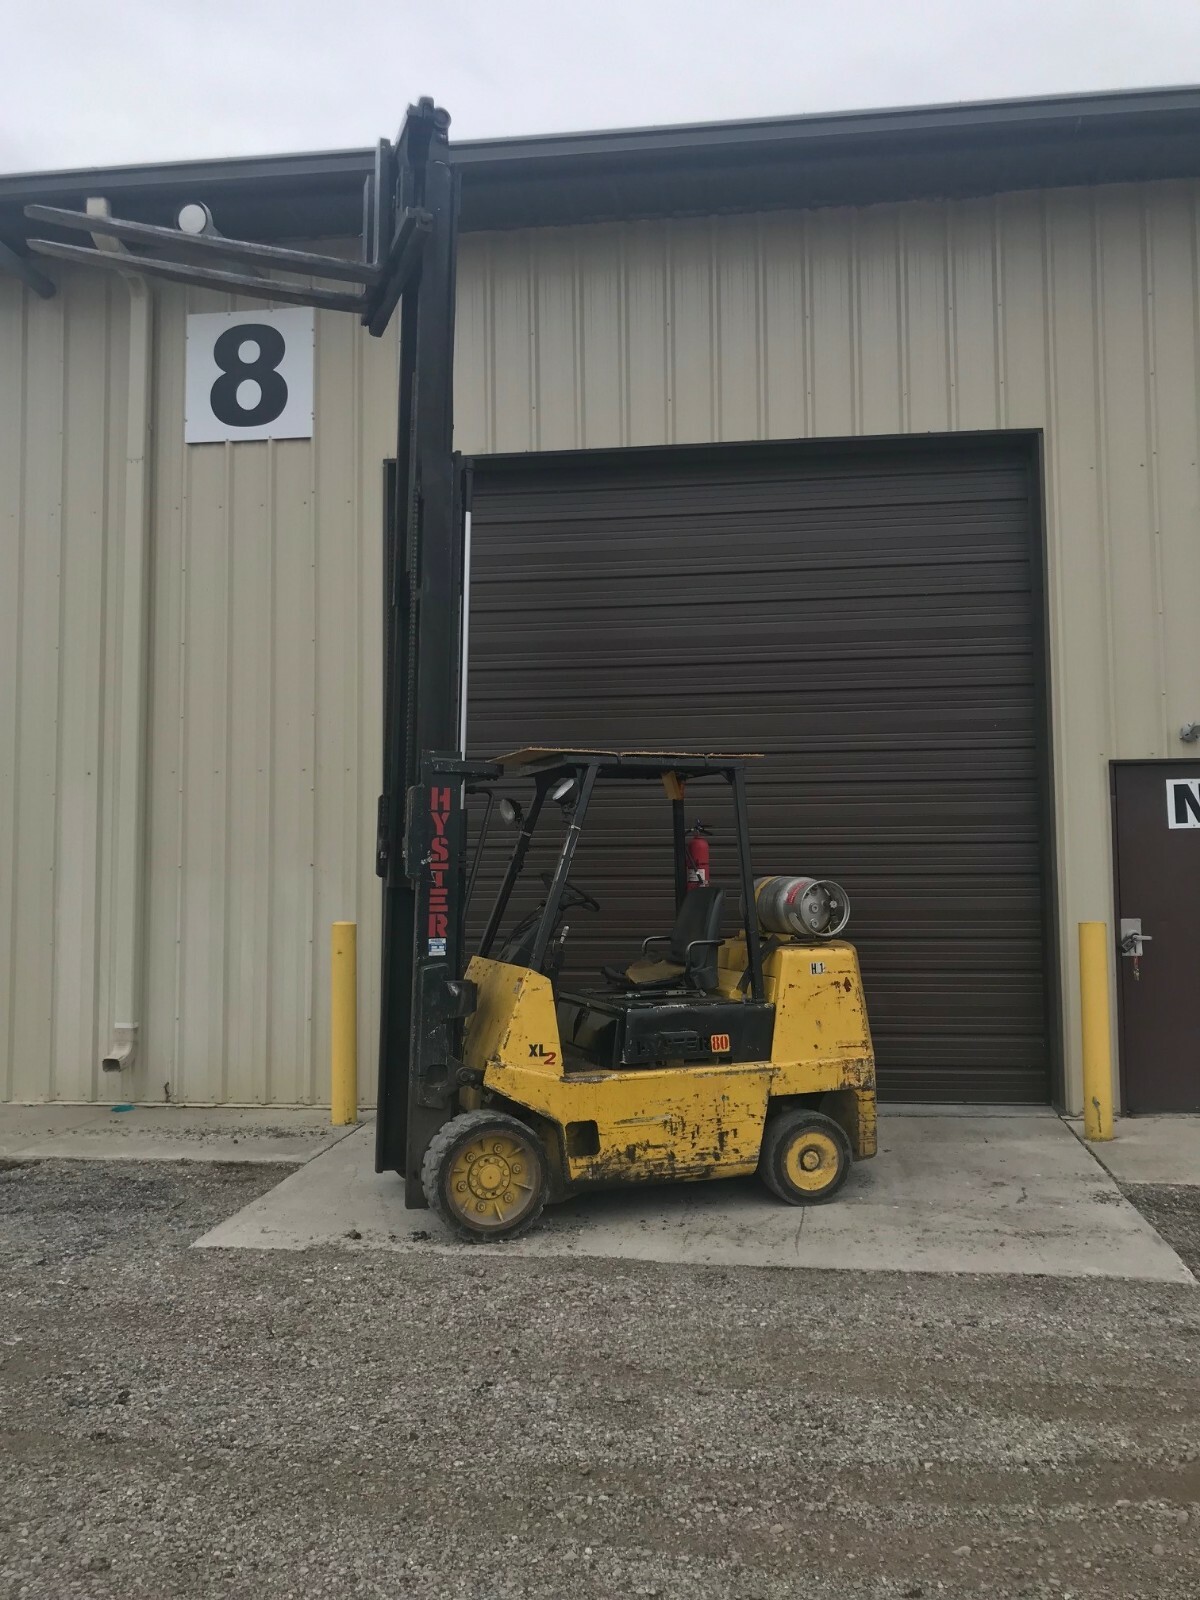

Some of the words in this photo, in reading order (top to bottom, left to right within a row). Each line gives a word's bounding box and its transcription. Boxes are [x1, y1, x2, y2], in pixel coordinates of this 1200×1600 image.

[210, 323, 289, 428] 8
[428, 786, 451, 938] HYSTER
[711, 1035, 729, 1051] 80
